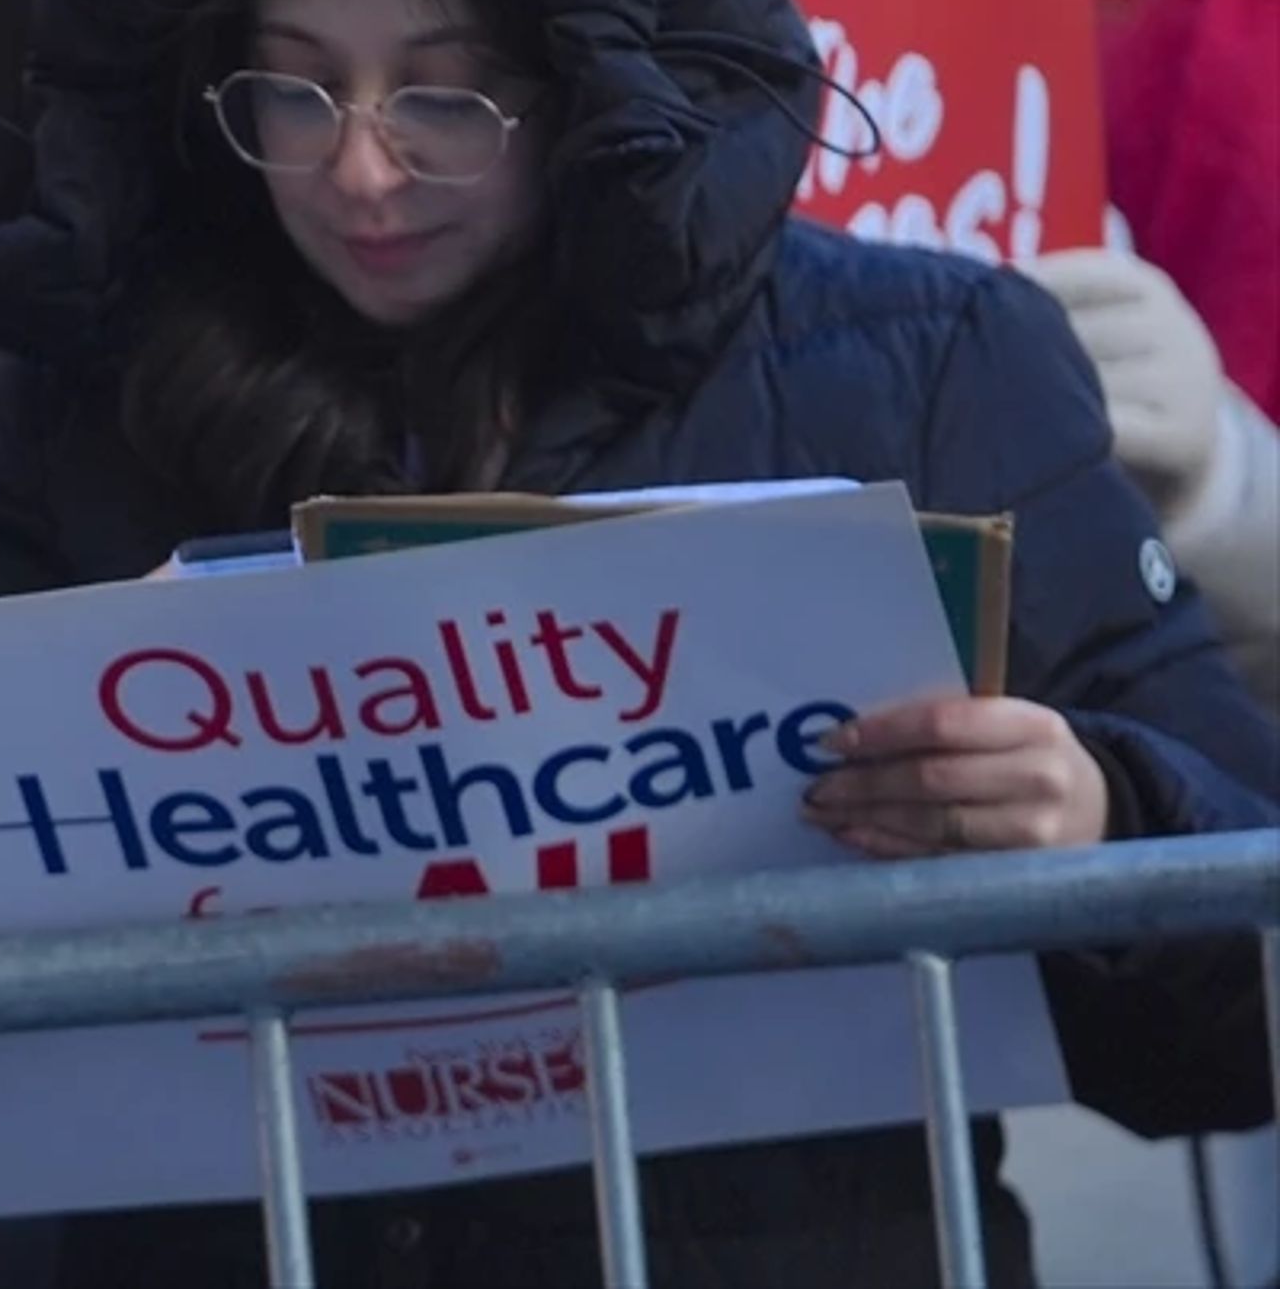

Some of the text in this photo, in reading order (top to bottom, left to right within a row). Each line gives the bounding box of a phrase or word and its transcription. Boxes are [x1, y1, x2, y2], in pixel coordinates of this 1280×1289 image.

[798, 15, 944, 200] he
[97, 608, 681, 754] Quality
[17, 699, 860, 877] Healthcare
[305, 1045, 587, 1128] NURSE
